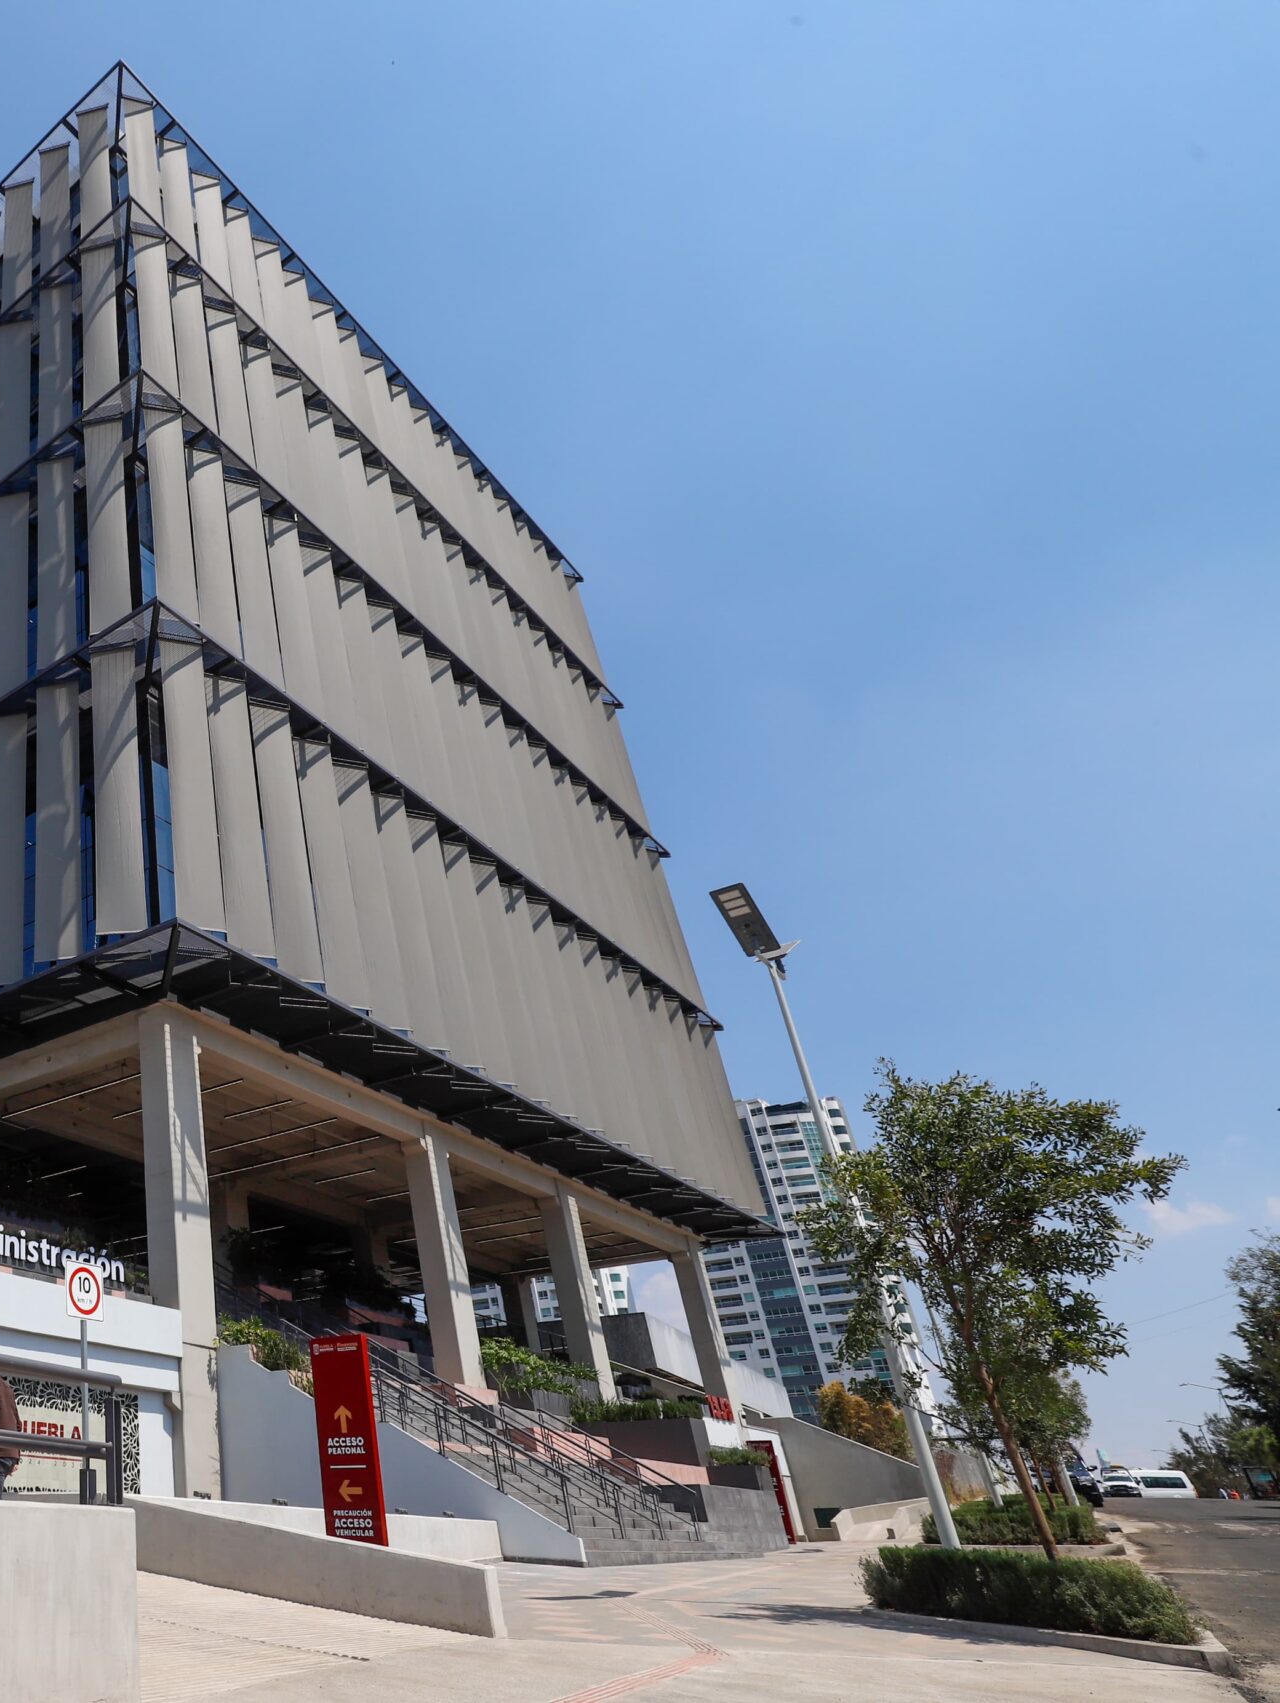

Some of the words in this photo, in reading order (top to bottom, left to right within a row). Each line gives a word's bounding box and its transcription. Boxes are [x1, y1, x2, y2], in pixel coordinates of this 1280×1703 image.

[78, 1276, 91, 1294] 10
[327, 1437, 364, 1446] ACCESO
[335, 1519, 372, 1527] ACCESO
[335, 1529, 374, 1537] VEHICULAR
